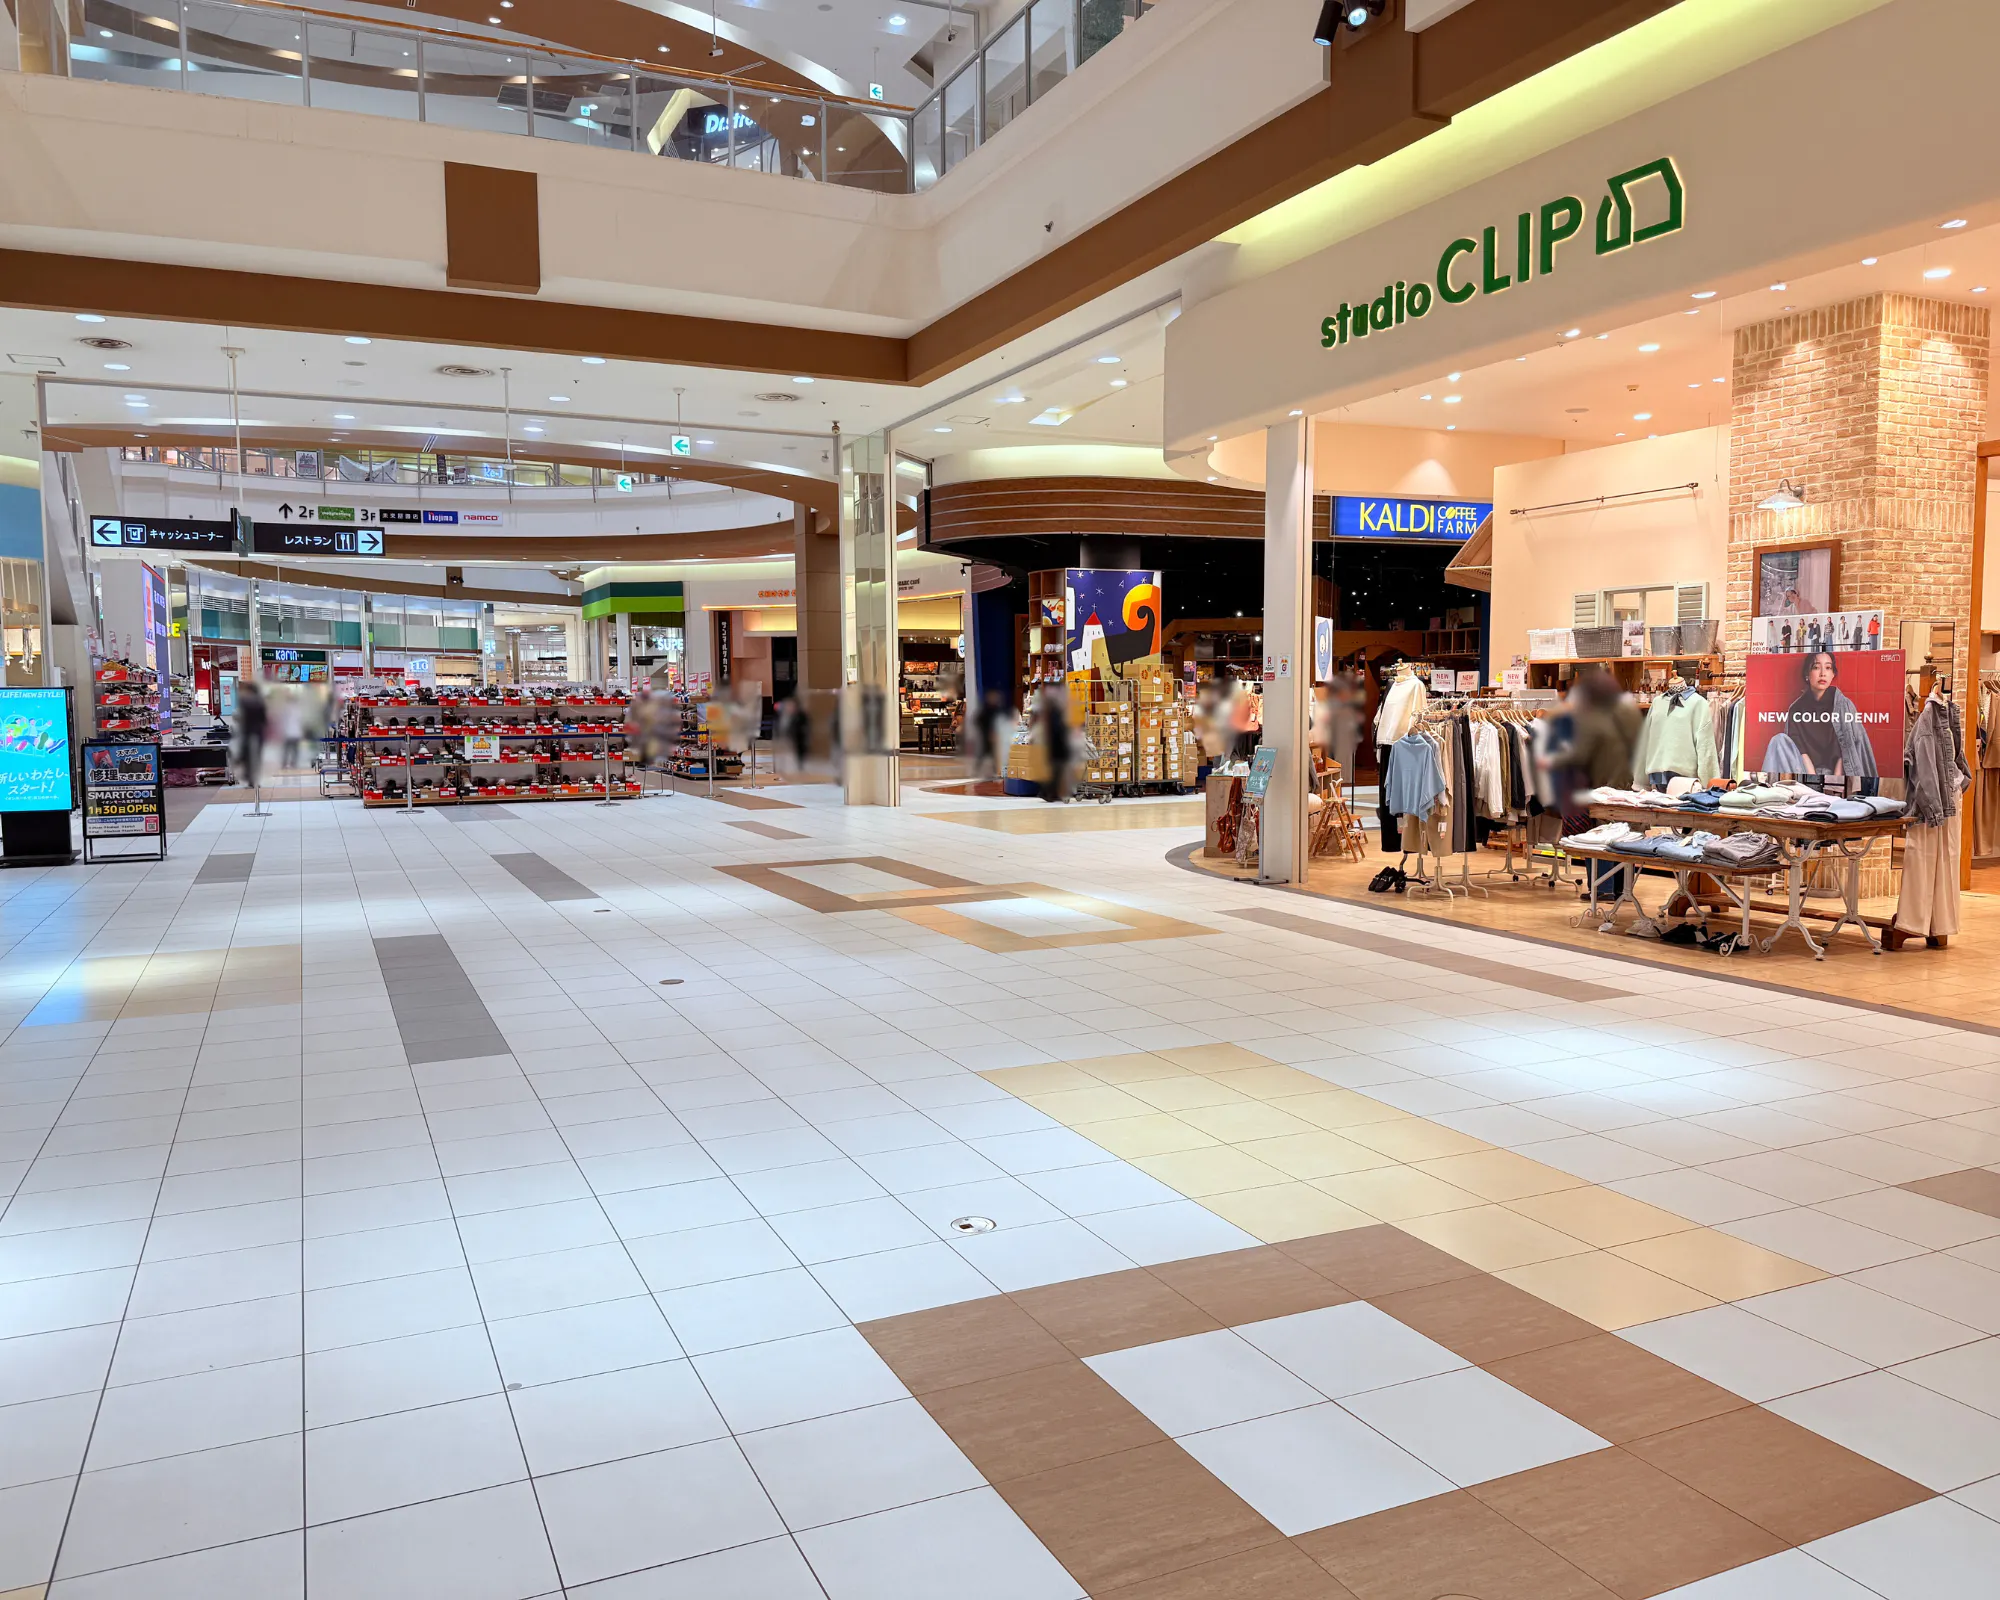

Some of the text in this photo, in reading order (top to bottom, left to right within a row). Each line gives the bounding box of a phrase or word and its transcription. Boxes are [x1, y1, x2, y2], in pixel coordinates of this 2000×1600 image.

[1320, 196, 1584, 349] studio CLIP
[298, 506, 315, 519] 2F
[360, 508, 376, 521] 3F
[463, 513, 499, 521] namco
[1359, 502, 1477, 533] KALDI COFFEE
[1437, 520, 1477, 534] FARM
[149, 528, 225, 541] キャッシュコーナー
[284, 535, 332, 546] レストラン
[1758, 711, 1890, 724] NEW COLOR DENIM
[116, 748, 139, 757] スマホ
[87, 790, 157, 800] SMARTCOOL
[127, 803, 157, 813] OPEN
